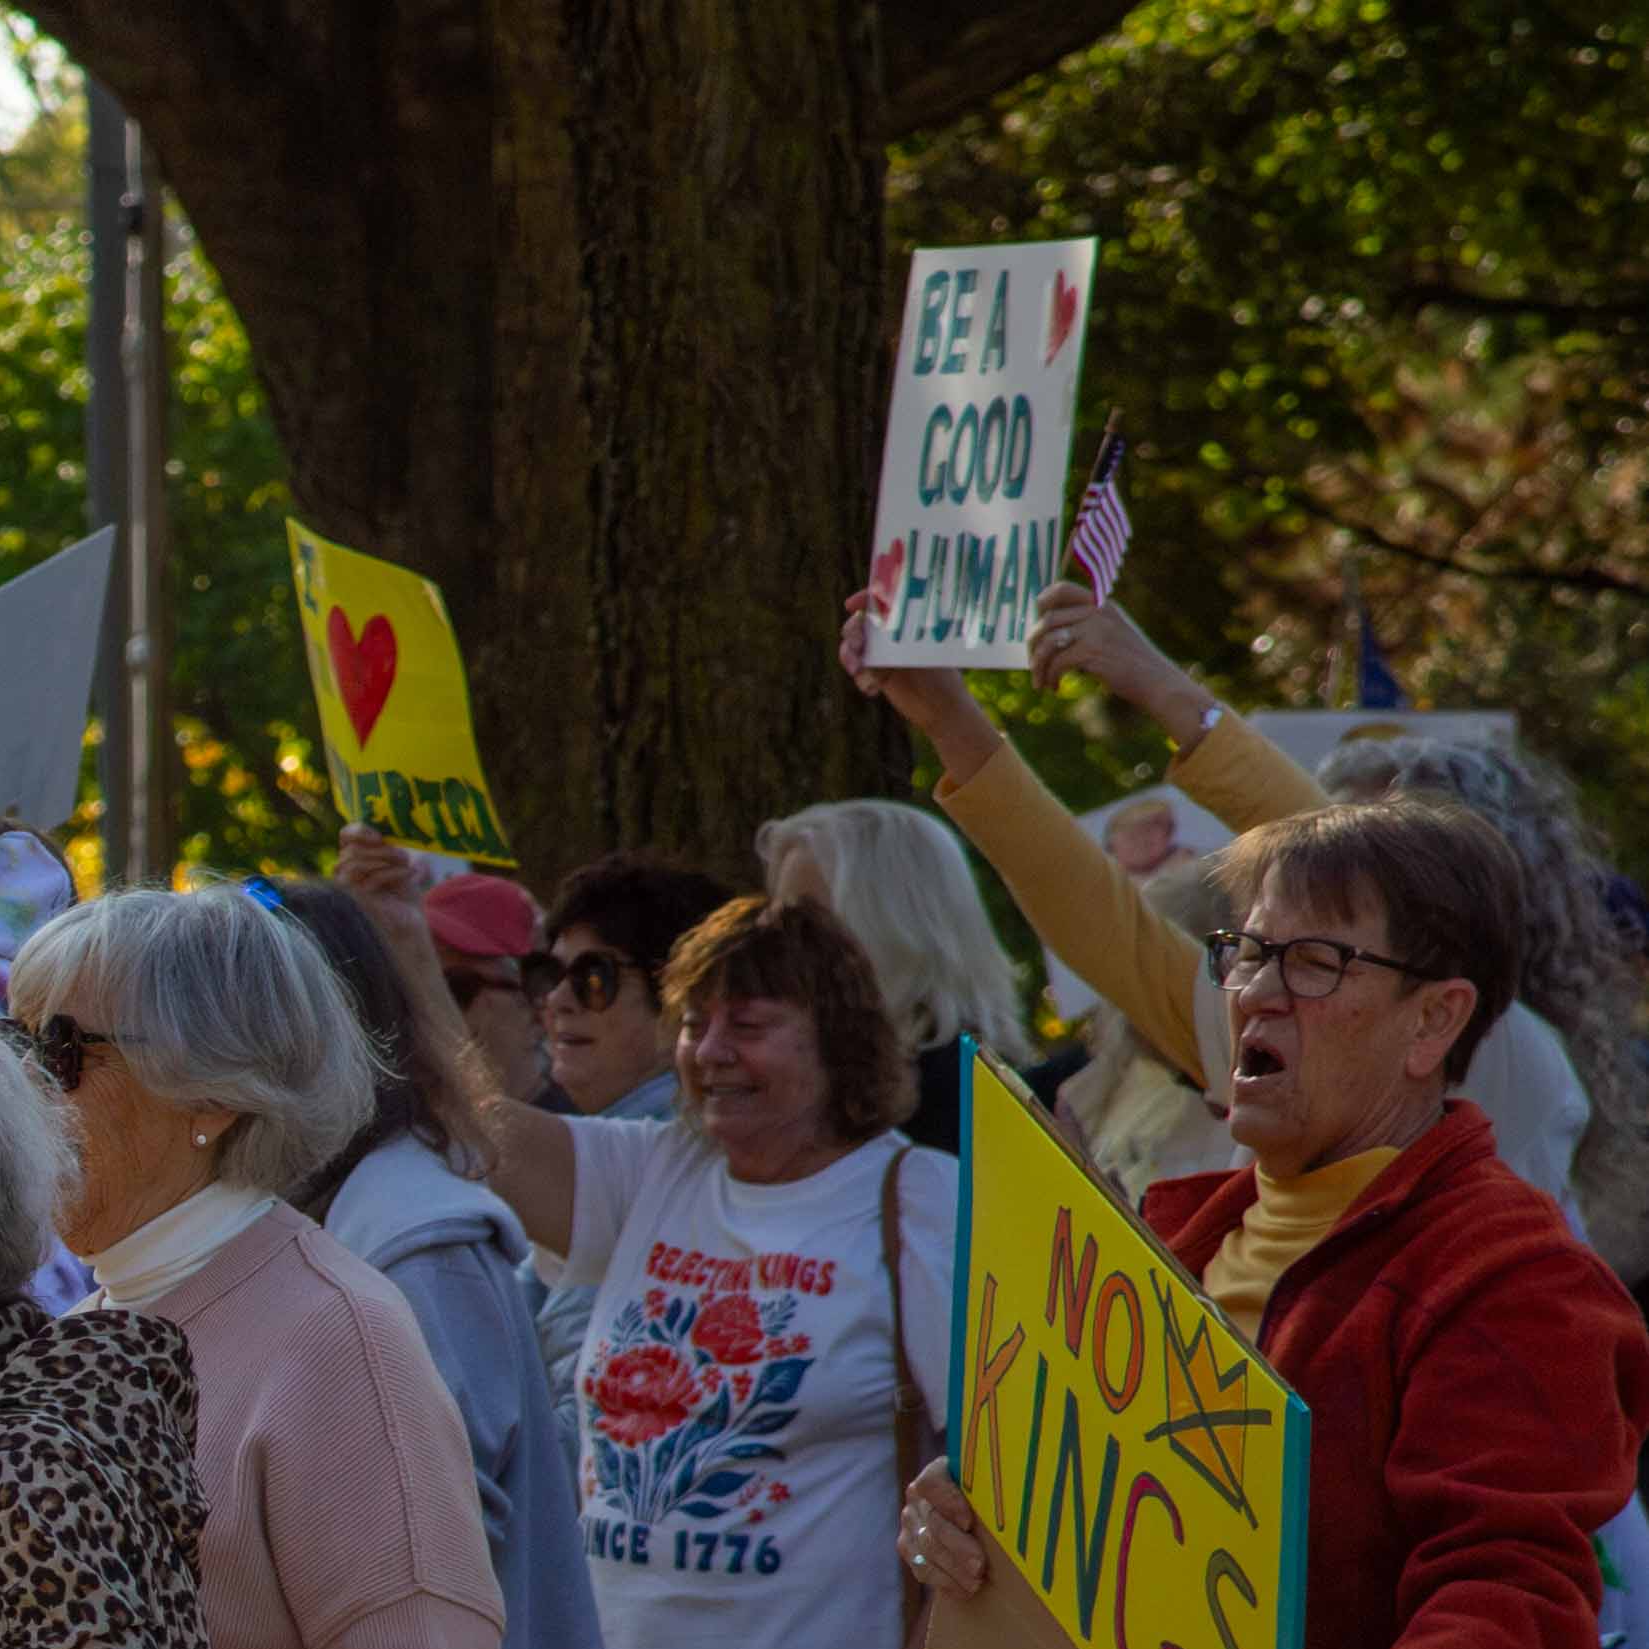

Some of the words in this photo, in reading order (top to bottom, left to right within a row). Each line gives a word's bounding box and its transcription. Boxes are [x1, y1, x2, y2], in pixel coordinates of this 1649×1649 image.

[913, 269, 979, 377] BE
[979, 268, 1010, 376] A
[918, 393, 1032, 507] GOOD
[892, 517, 1058, 643] HUMAN
[646, 1240, 753, 1293] REJECTIN
[758, 1252, 836, 1297] KINGS
[1044, 1204, 1145, 1415] NO
[584, 1515, 650, 1566] INCE
[674, 1529, 782, 1576] 1776
